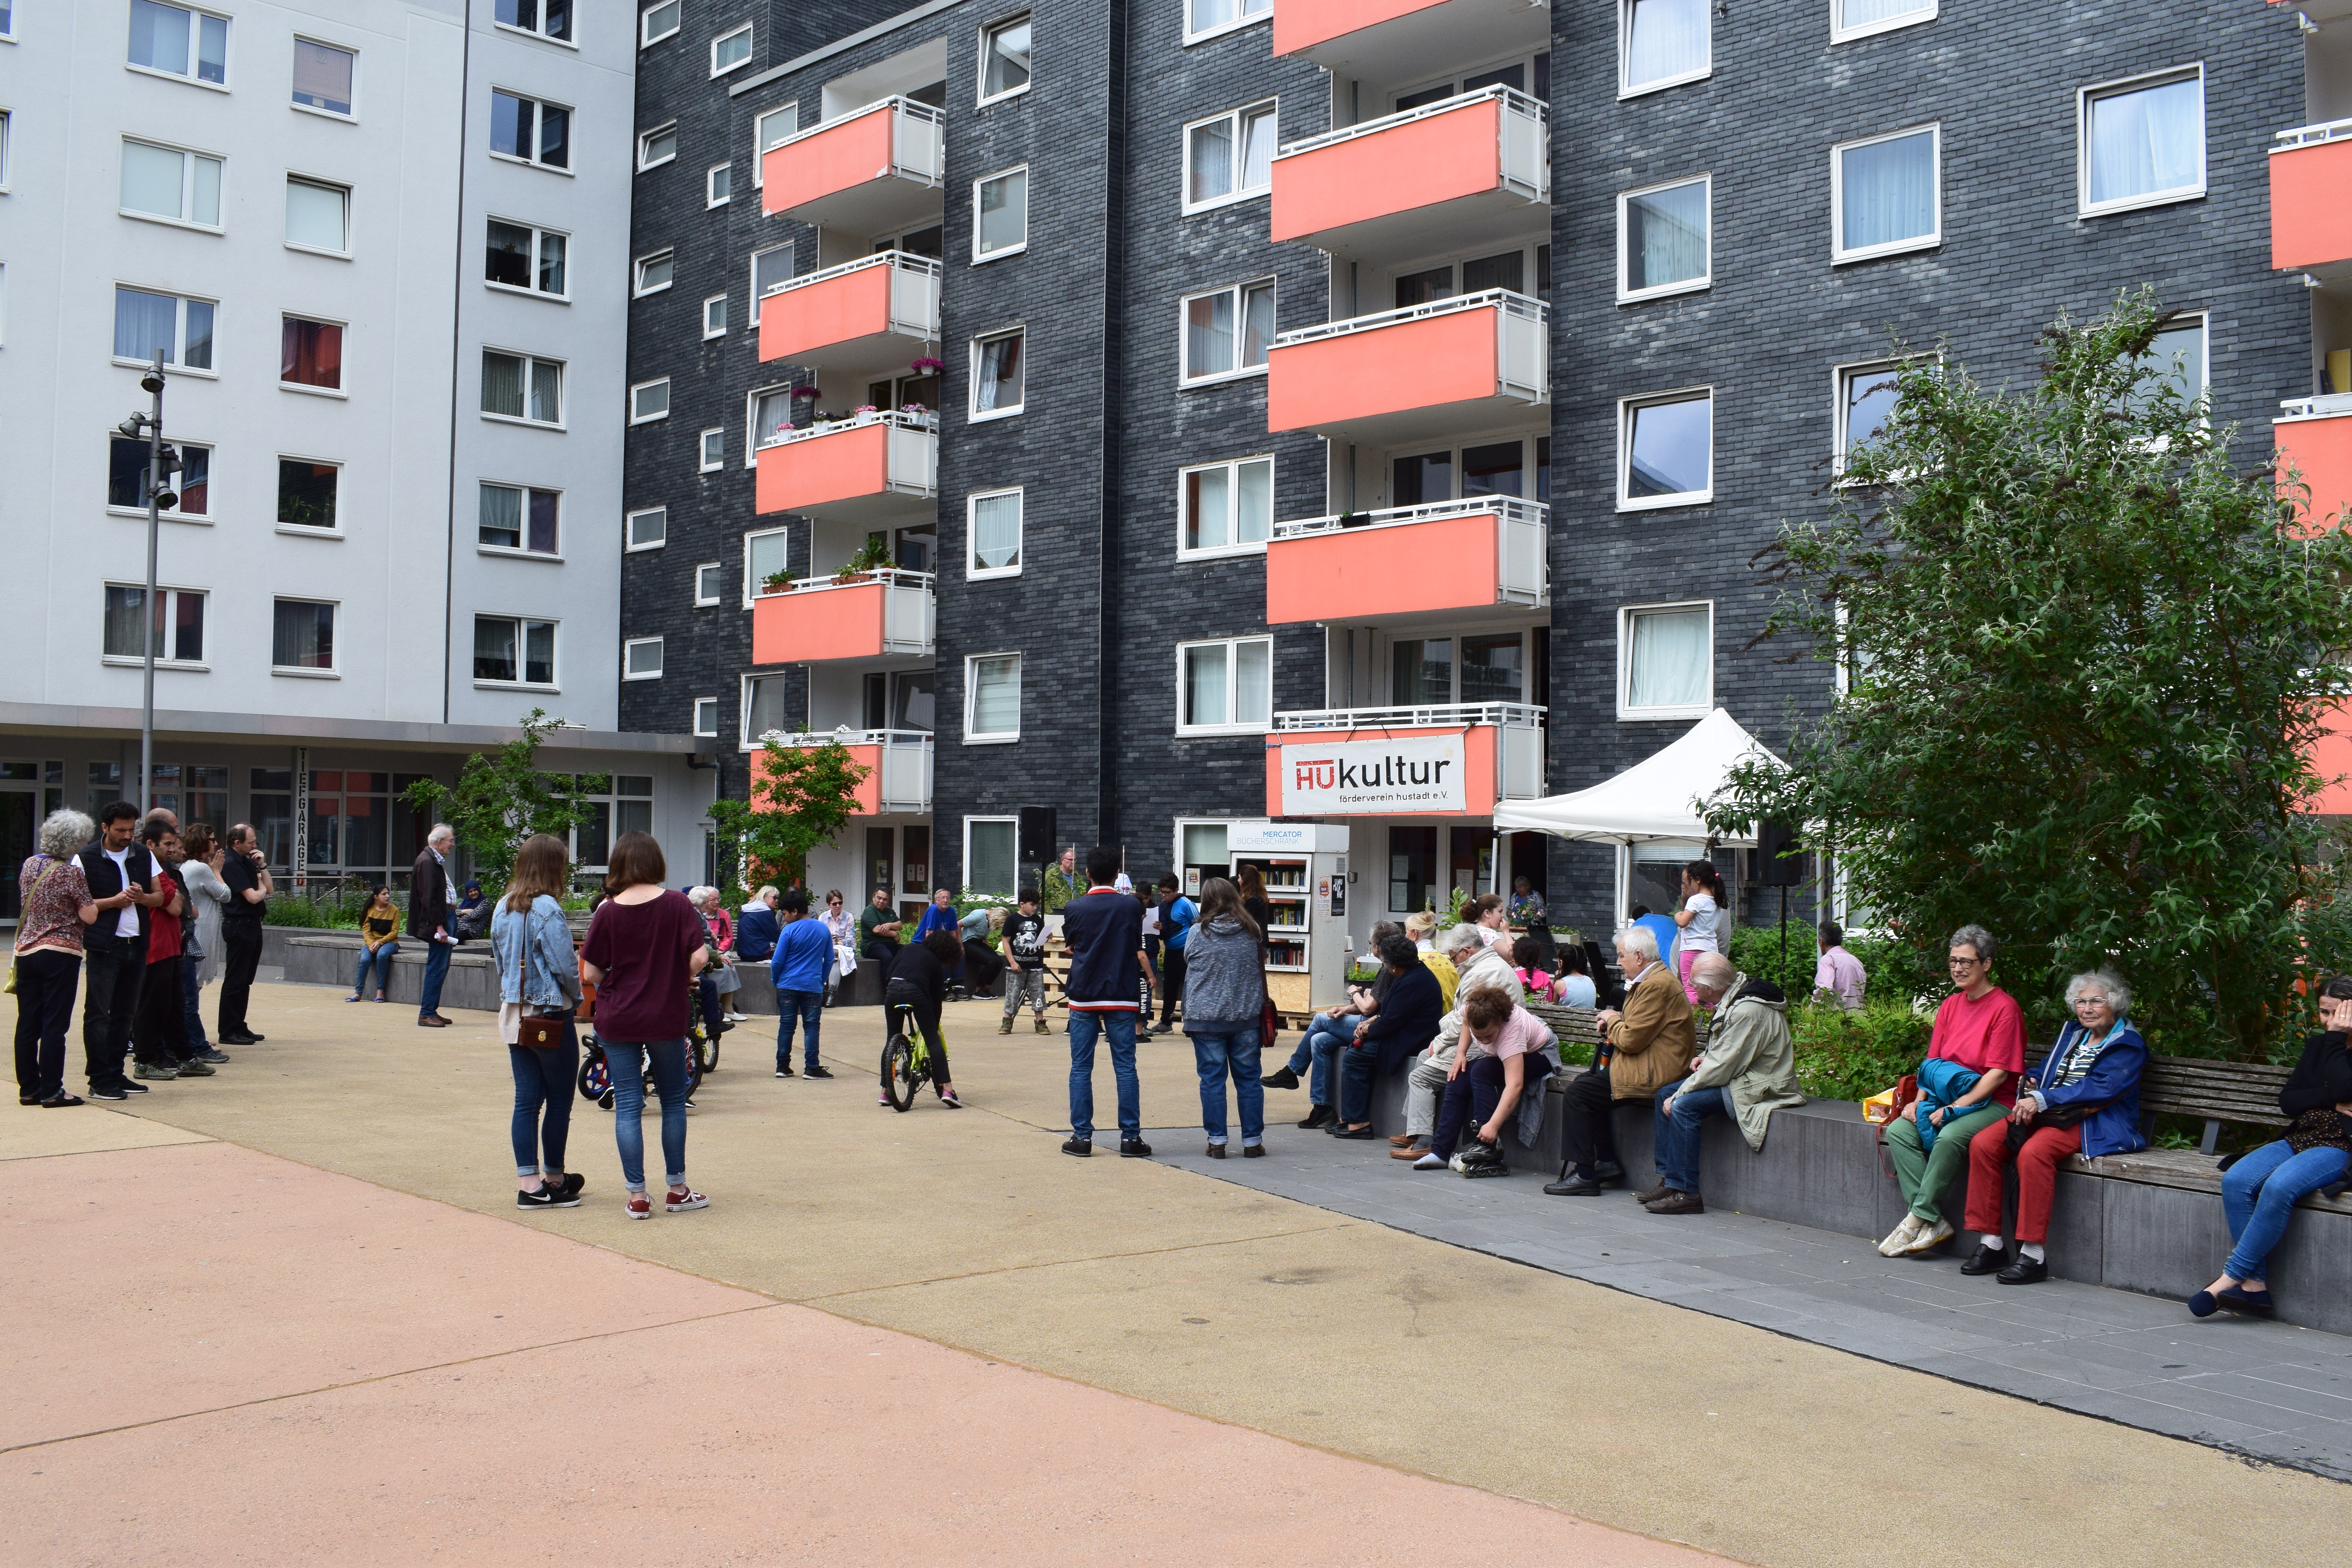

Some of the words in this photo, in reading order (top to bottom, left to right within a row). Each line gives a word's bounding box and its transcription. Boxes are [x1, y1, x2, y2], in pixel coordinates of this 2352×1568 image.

[298, 748, 307, 871] TIEFGARAGE
[1339, 793, 1394, 803] förderverein
[1396, 792, 1430, 800] hustadt
[1433, 791, 1448, 799] e.V.
